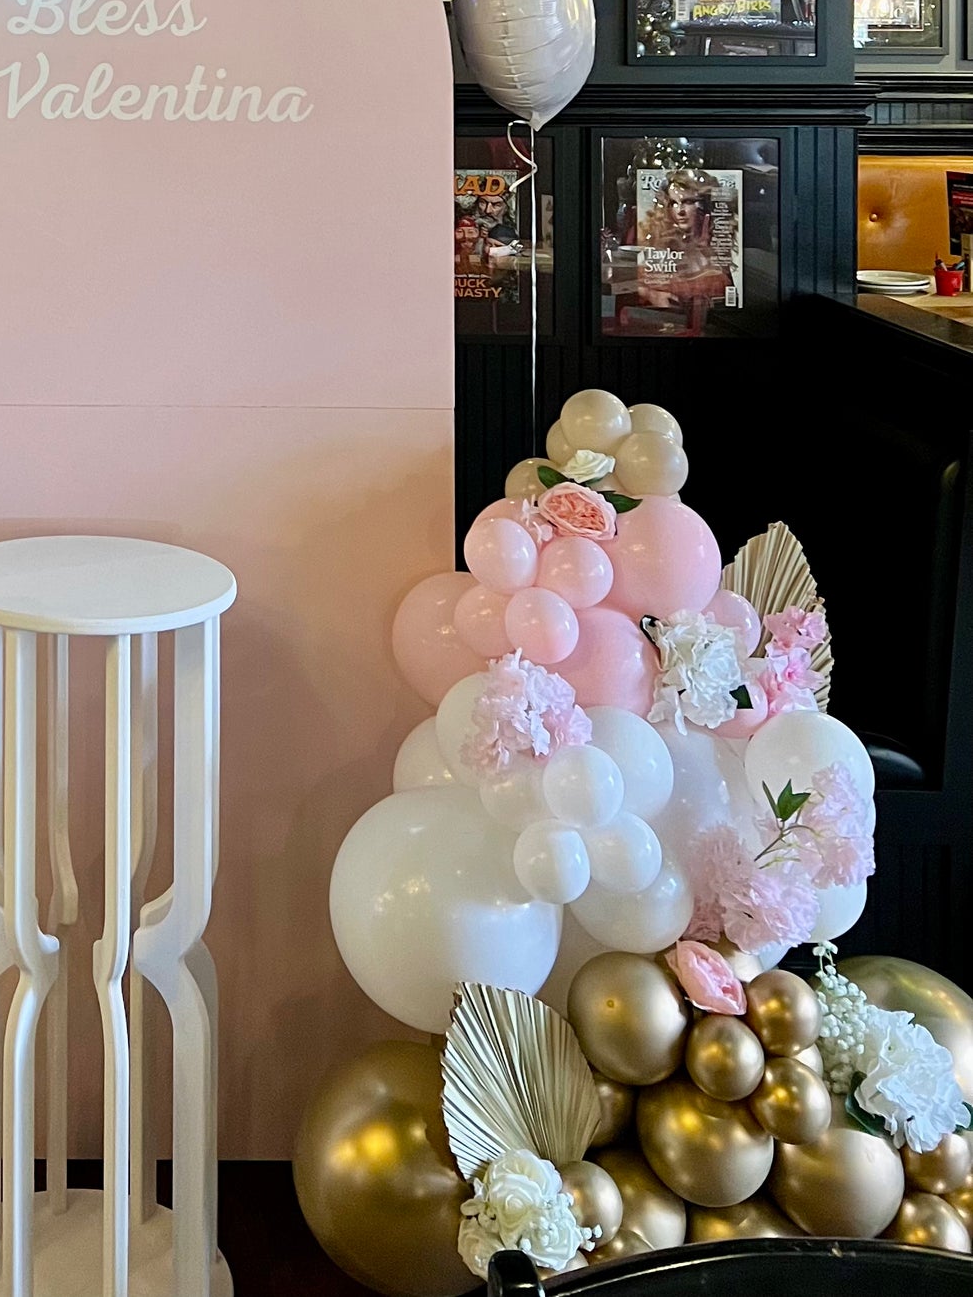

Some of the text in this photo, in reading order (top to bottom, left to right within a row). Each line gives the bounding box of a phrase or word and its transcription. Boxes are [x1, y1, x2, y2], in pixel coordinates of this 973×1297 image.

[693, 4, 731, 20] ANGRY
[644, 246, 685, 264] Taylor
[644, 259, 677, 273] Swift
[455, 278, 486, 288] UCK
[455, 287, 503, 298] NASTY
